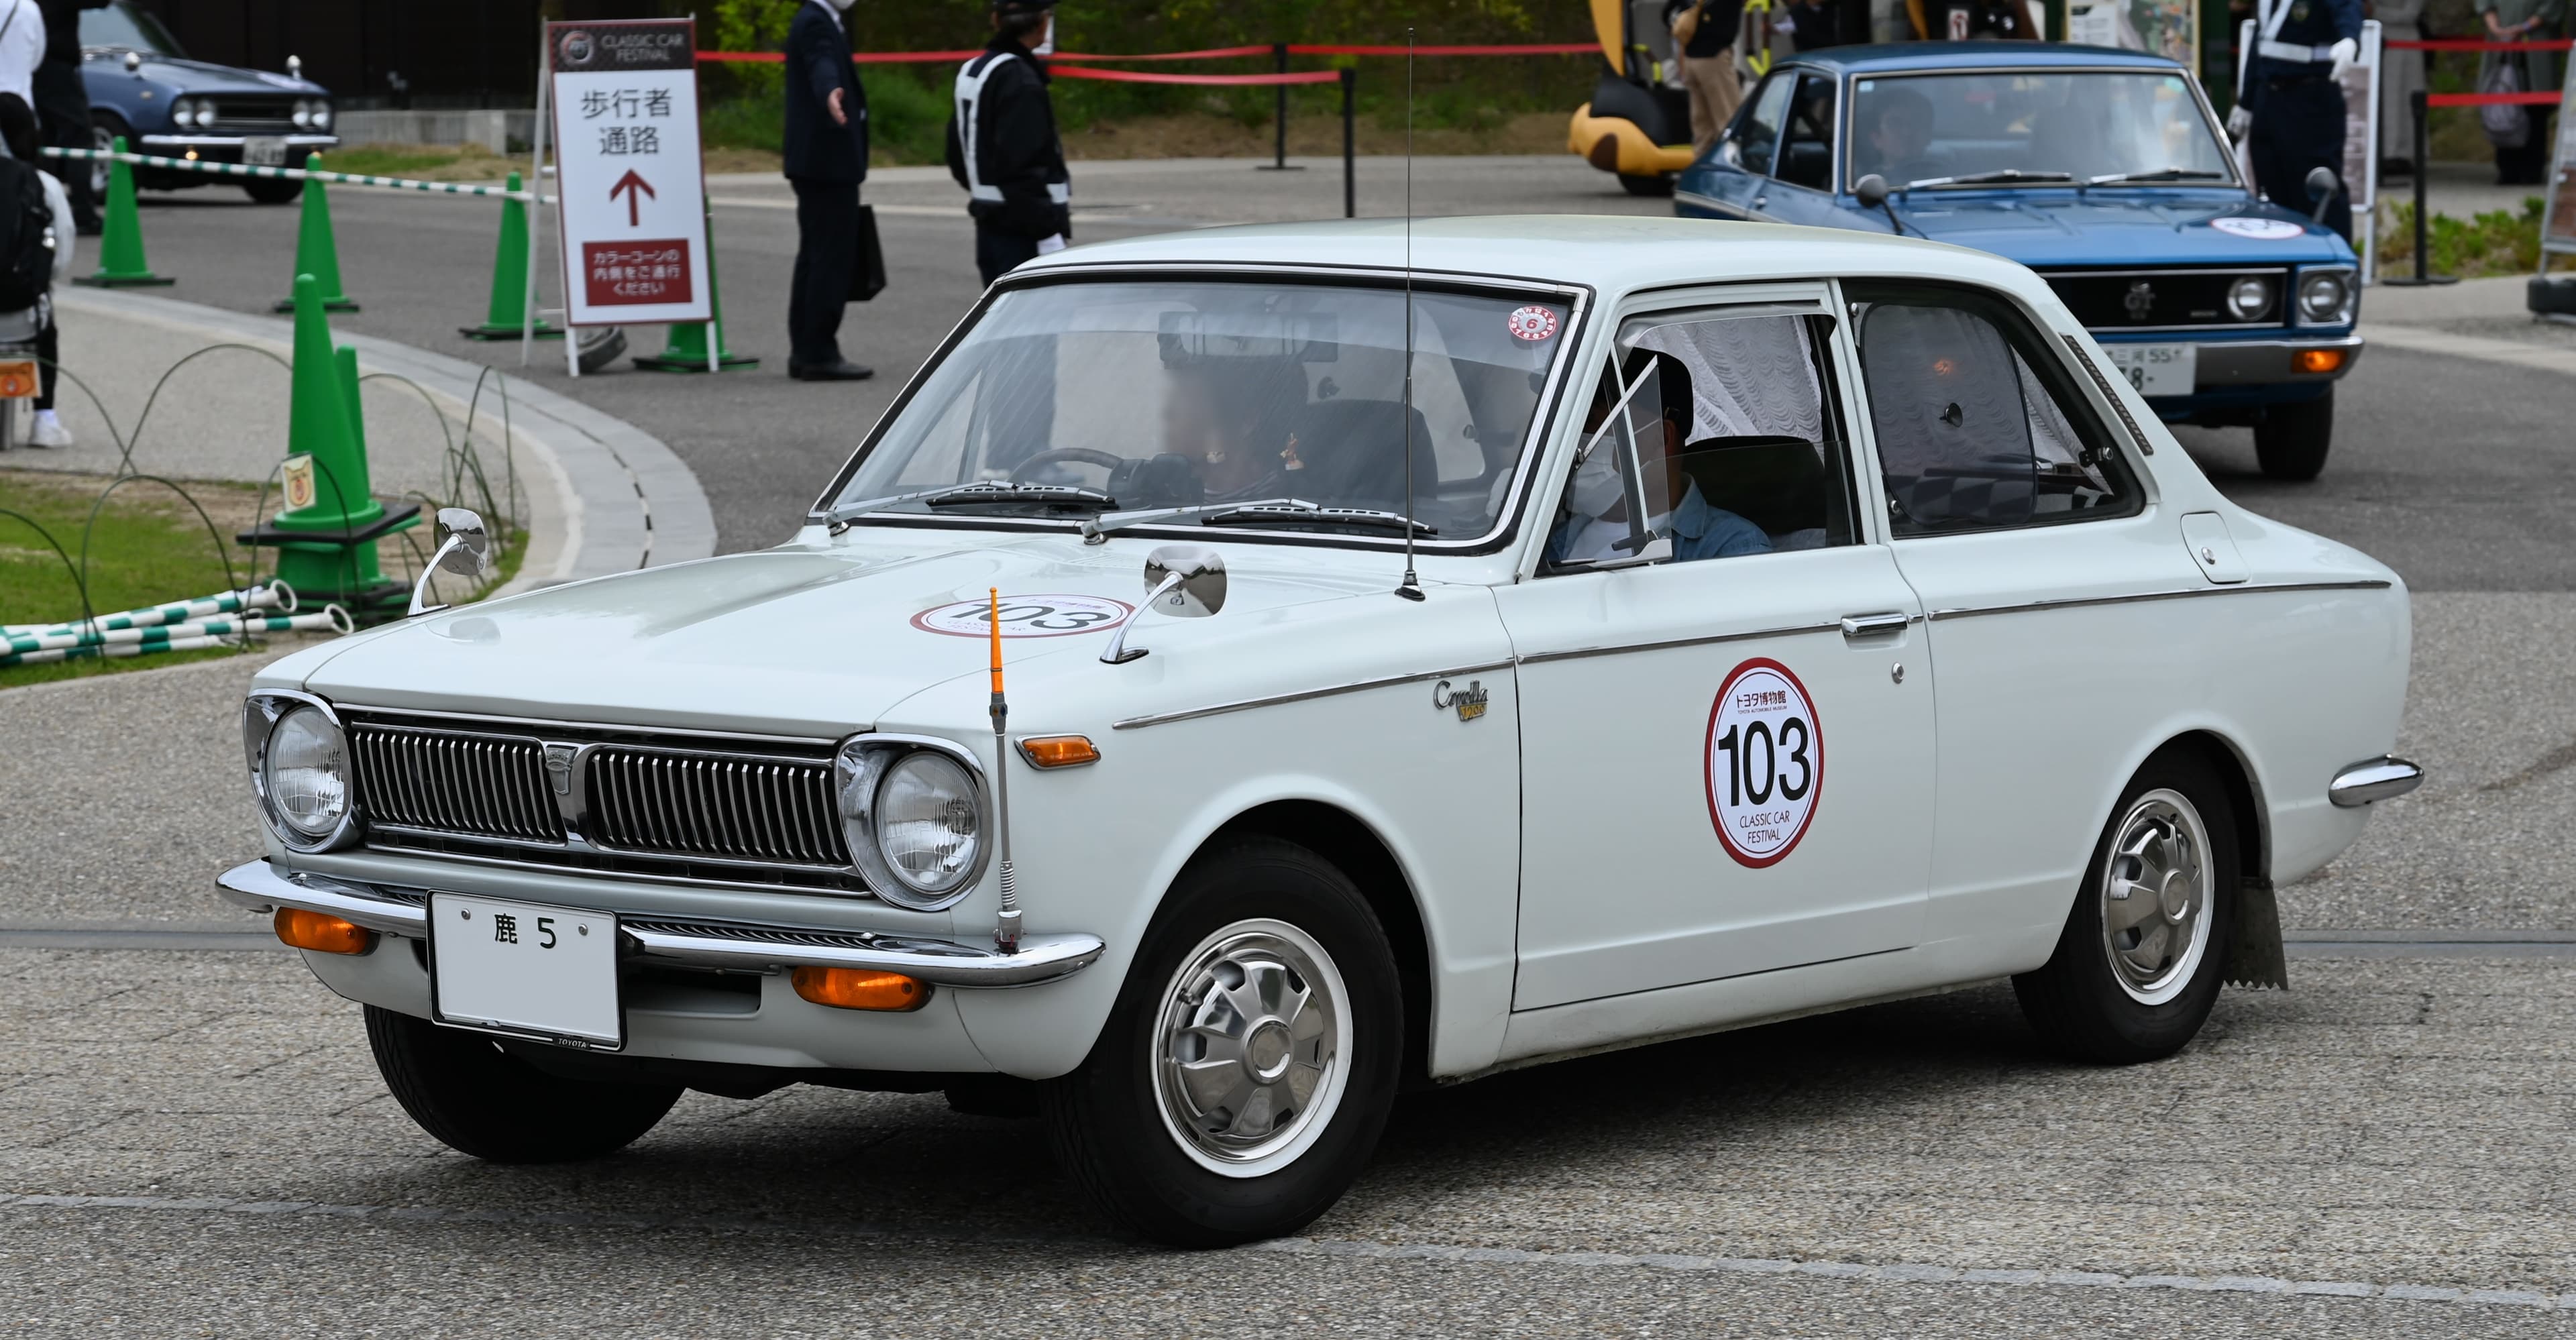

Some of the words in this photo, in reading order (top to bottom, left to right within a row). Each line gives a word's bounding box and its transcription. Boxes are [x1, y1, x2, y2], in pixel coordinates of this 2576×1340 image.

[601, 35, 655, 48] CLASSIC
[656, 34, 684, 46] CAR
[616, 49, 672, 62] FESTIVAL
[581, 89, 673, 119] 歩行者
[599, 125, 660, 155] 通路
[594, 249, 680, 265] カラーコーンの
[613, 281, 665, 296] ください
[1526, 319, 1538, 329] 6
[950, 603, 1111, 629] 103
[1736, 690, 1786, 708] トヨタ博物館
[1718, 717, 1811, 807] 103
[1739, 812, 1772, 828] CLASSIC
[1774, 810, 1790, 824] CAR
[1748, 828, 1781, 844] FESTIVAL
[494, 913, 517, 944] 鹿
[537, 917, 556, 949] 5
[558, 1038, 587, 1048] TOYOTA
